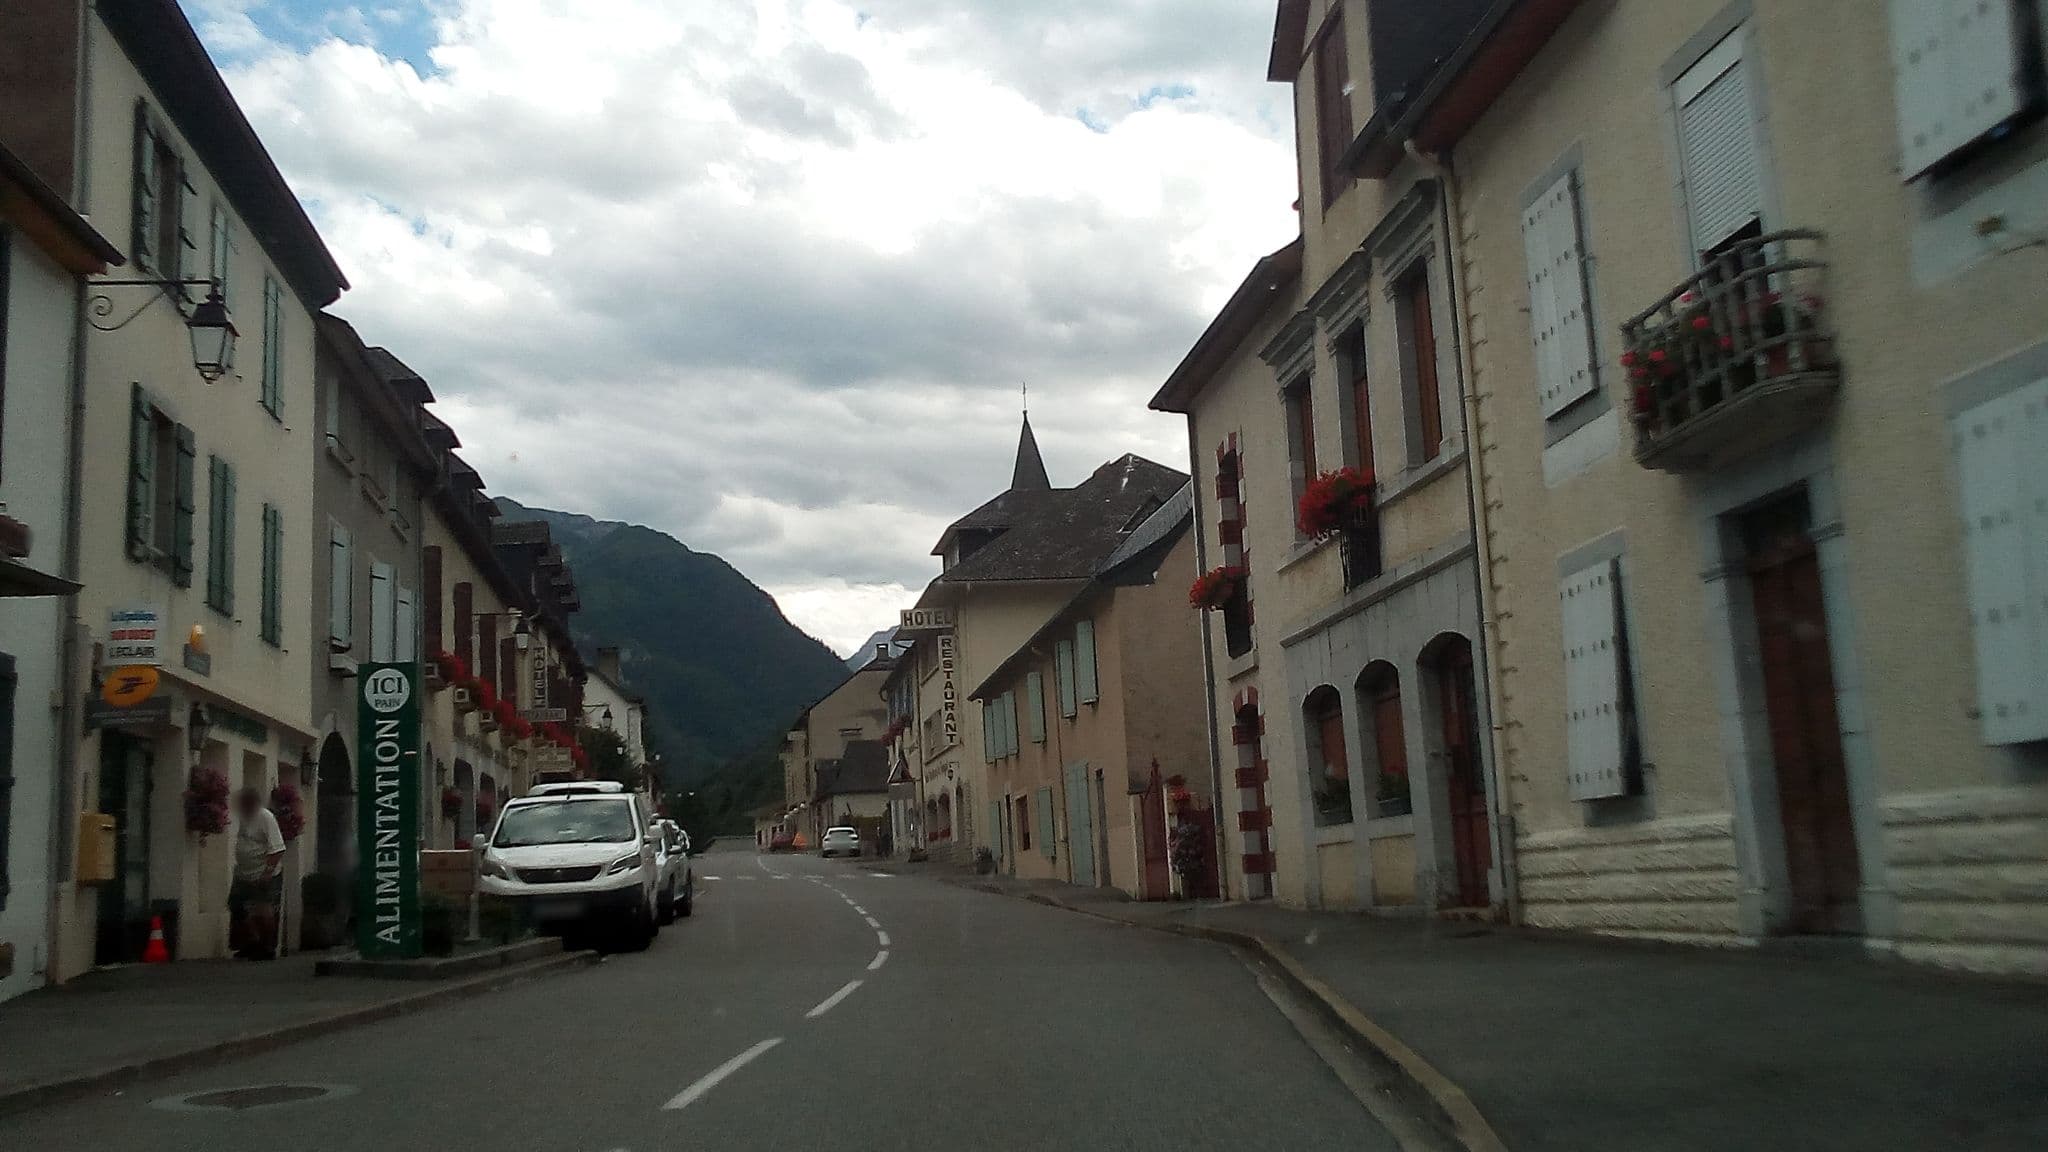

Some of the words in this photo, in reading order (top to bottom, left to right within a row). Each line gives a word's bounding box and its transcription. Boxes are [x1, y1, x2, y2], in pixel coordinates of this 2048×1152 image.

[903, 611, 952, 626] HOTEL
[372, 677, 403, 694] ICI
[941, 638, 957, 743] RESTAURANT
[374, 698, 401, 708] PAIN
[375, 719, 400, 944] ALIMENTATION
